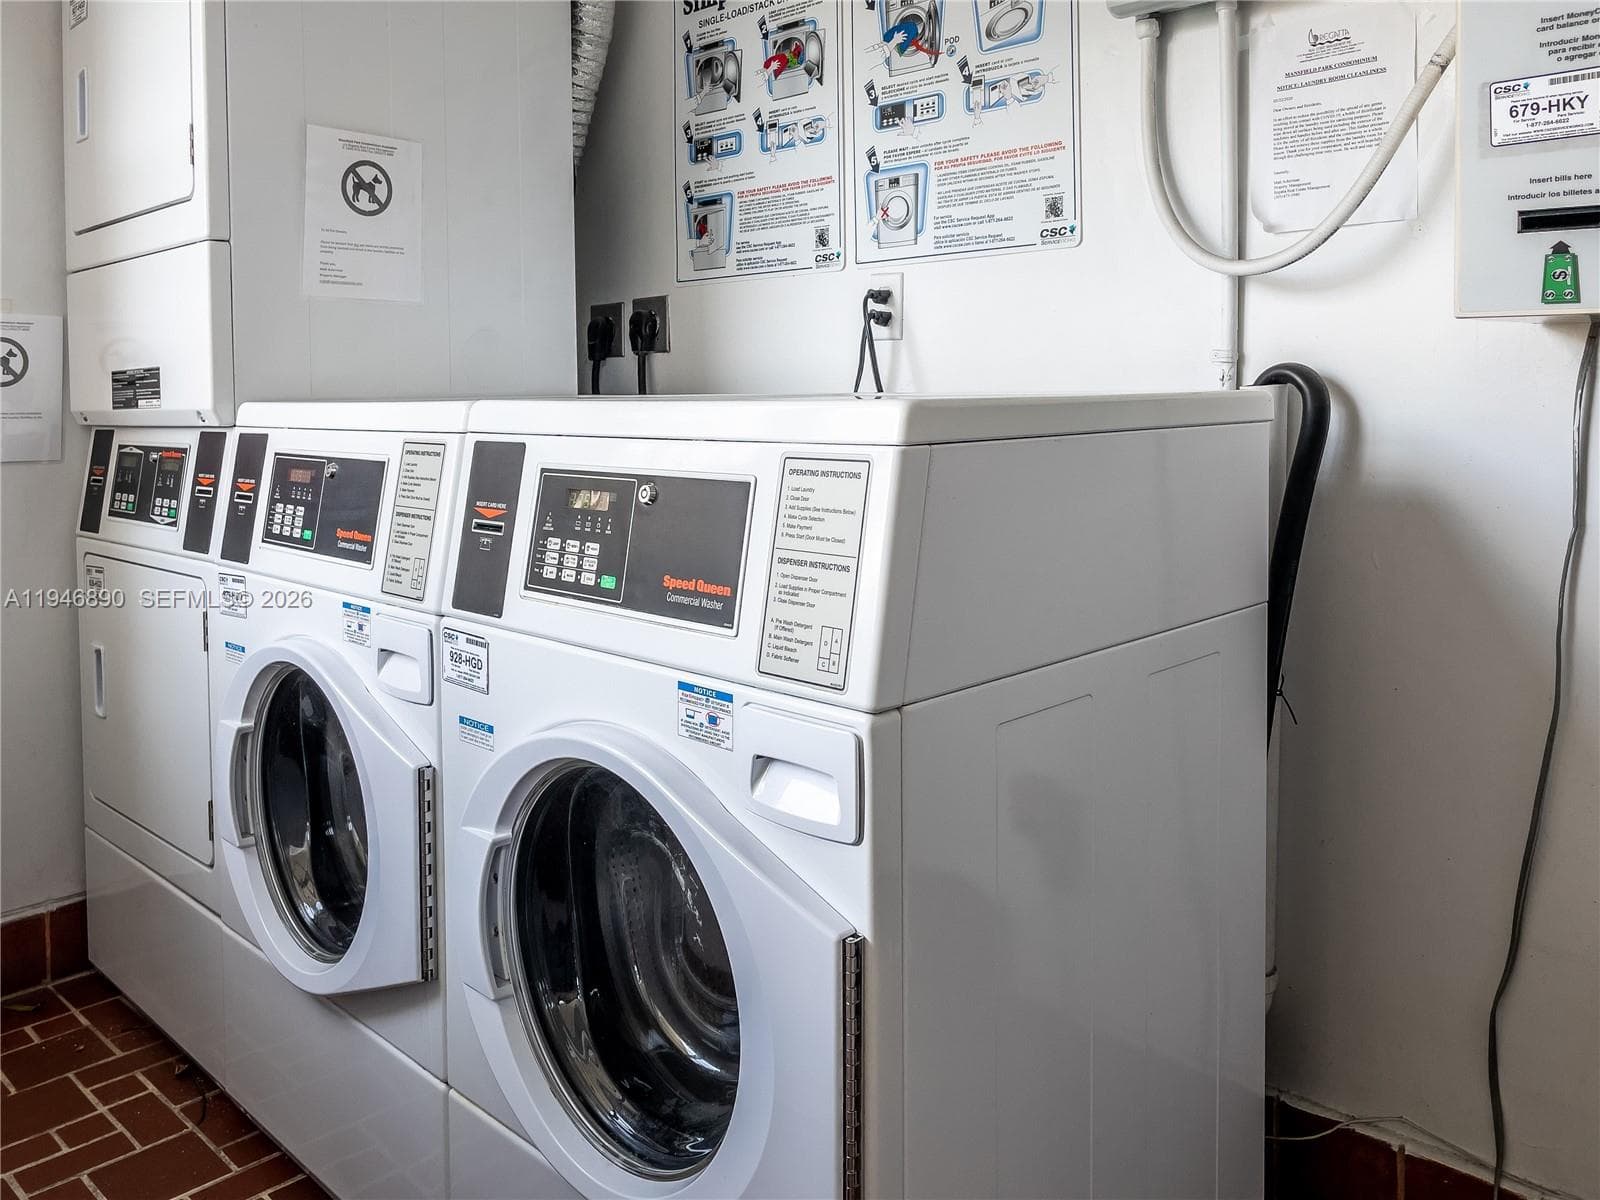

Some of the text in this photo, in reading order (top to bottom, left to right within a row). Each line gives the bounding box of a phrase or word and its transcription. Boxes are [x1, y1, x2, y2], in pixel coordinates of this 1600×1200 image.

[1541, 15, 1564, 24] Insert
[761, 24, 768, 34] 2
[1537, 25, 1554, 33] card
[1557, 20, 1590, 30] balance
[945, 36, 960, 45] POD
[1319, 29, 1350, 41] REGATTA
[1540, 37, 1579, 49] Introducir
[1549, 43, 1595, 57] para recibir
[1565, 52, 1597, 62] agregar
[962, 67, 969, 76] 4
[1285, 56, 1378, 78] MANSFIELD PARK CONDOMINIUM
[1300, 79, 1327, 88] LAUNDRY
[1328, 75, 1346, 83] ROOM
[1347, 67, 1387, 79] CLEANLINESS
[871, 91, 877, 99] 3
[1494, 84, 1522, 95] CSC
[1510, 95, 1590, 119] 679-HKY
[686, 129, 692, 138] 3
[946, 158, 959, 166] YOUR
[960, 155, 980, 163] SAFETY
[981, 151, 1001, 160] PLEASE
[1031, 141, 1064, 151] FOLLOWING
[870, 156, 878, 166] 5
[1530, 176, 1553, 184] Insert
[687, 189, 692, 198] 5
[1508, 193, 1547, 201] Introducir
[1563, 189, 1593, 197] billetes
[1040, 226, 1068, 238] CSC
[815, 253, 835, 263] CSC
[789, 469, 862, 480] OPERATING INSTRUCTIONS
[336, 528, 373, 543] Speed Queen
[778, 557, 851, 573] DISPENSER INSTRUCTIONS
[663, 575, 732, 597] Speed Queen
[821, 589, 847, 598] Compartment
[666, 592, 724, 610] Commercial Washer
[788, 599, 806, 607] Dispenser
[780, 626, 795, 634] Offered)
[794, 622, 813, 630] Detergent
[444, 631, 456, 641] CSC
[795, 638, 814, 647] Detergent
[450, 650, 483, 671] 928-HGD
[785, 655, 800, 664] Softener
[694, 687, 717, 698] NOTICE
[464, 718, 489, 732] NOTICE
